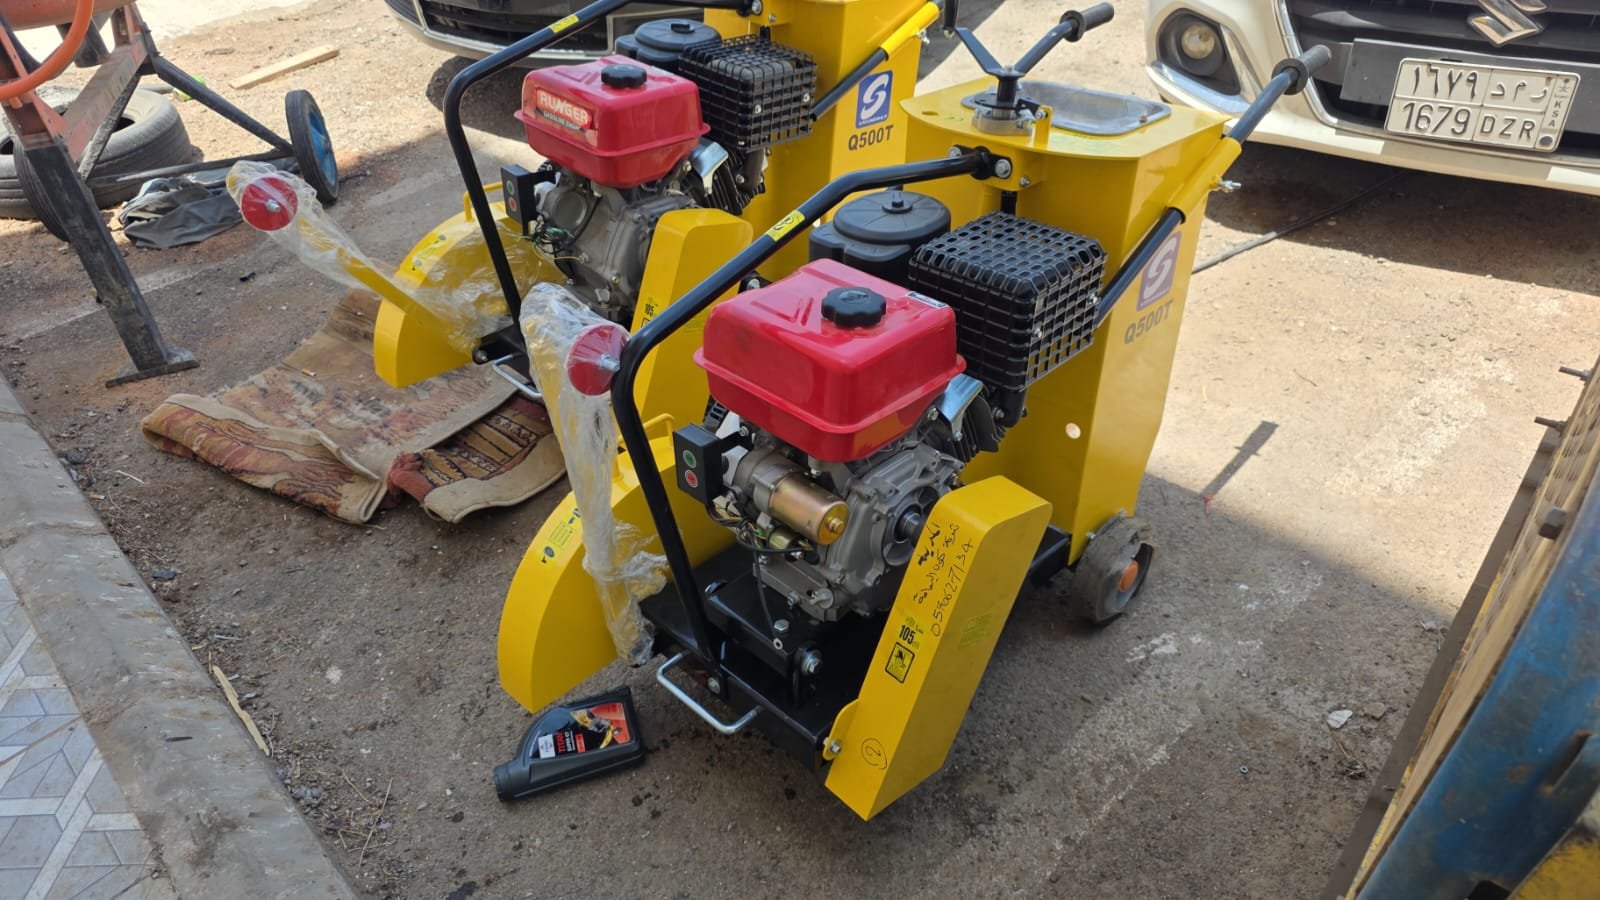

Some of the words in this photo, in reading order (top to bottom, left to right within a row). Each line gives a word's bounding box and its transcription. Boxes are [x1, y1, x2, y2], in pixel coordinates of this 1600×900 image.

[1412, 64, 1479, 99] ١٦٧٩
[848, 124, 894, 151] Q500T
[1402, 102, 1471, 135] 1679
[1479, 114, 1536, 141] DZR
[1124, 298, 1174, 344] Q500T
[899, 624, 915, 645] 105
